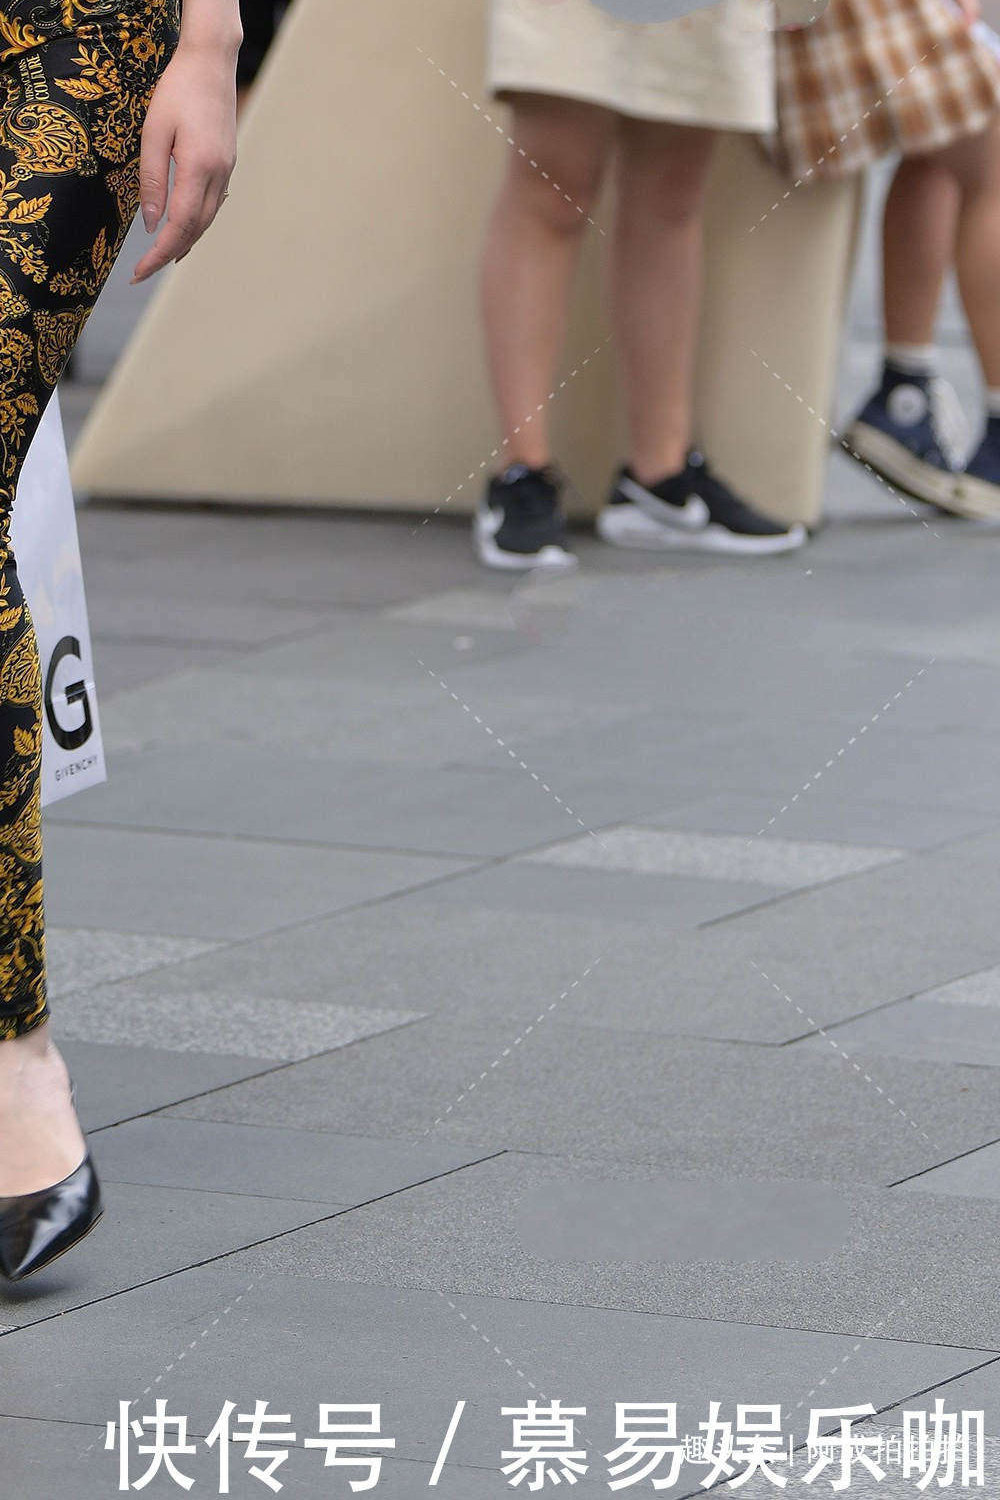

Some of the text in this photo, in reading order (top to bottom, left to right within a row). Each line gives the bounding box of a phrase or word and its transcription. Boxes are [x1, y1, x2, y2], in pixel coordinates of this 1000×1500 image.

[26, 53, 50, 101] COUTURE
[44, 635, 94, 751] G
[55, 755, 99, 782] GIVENCHY
